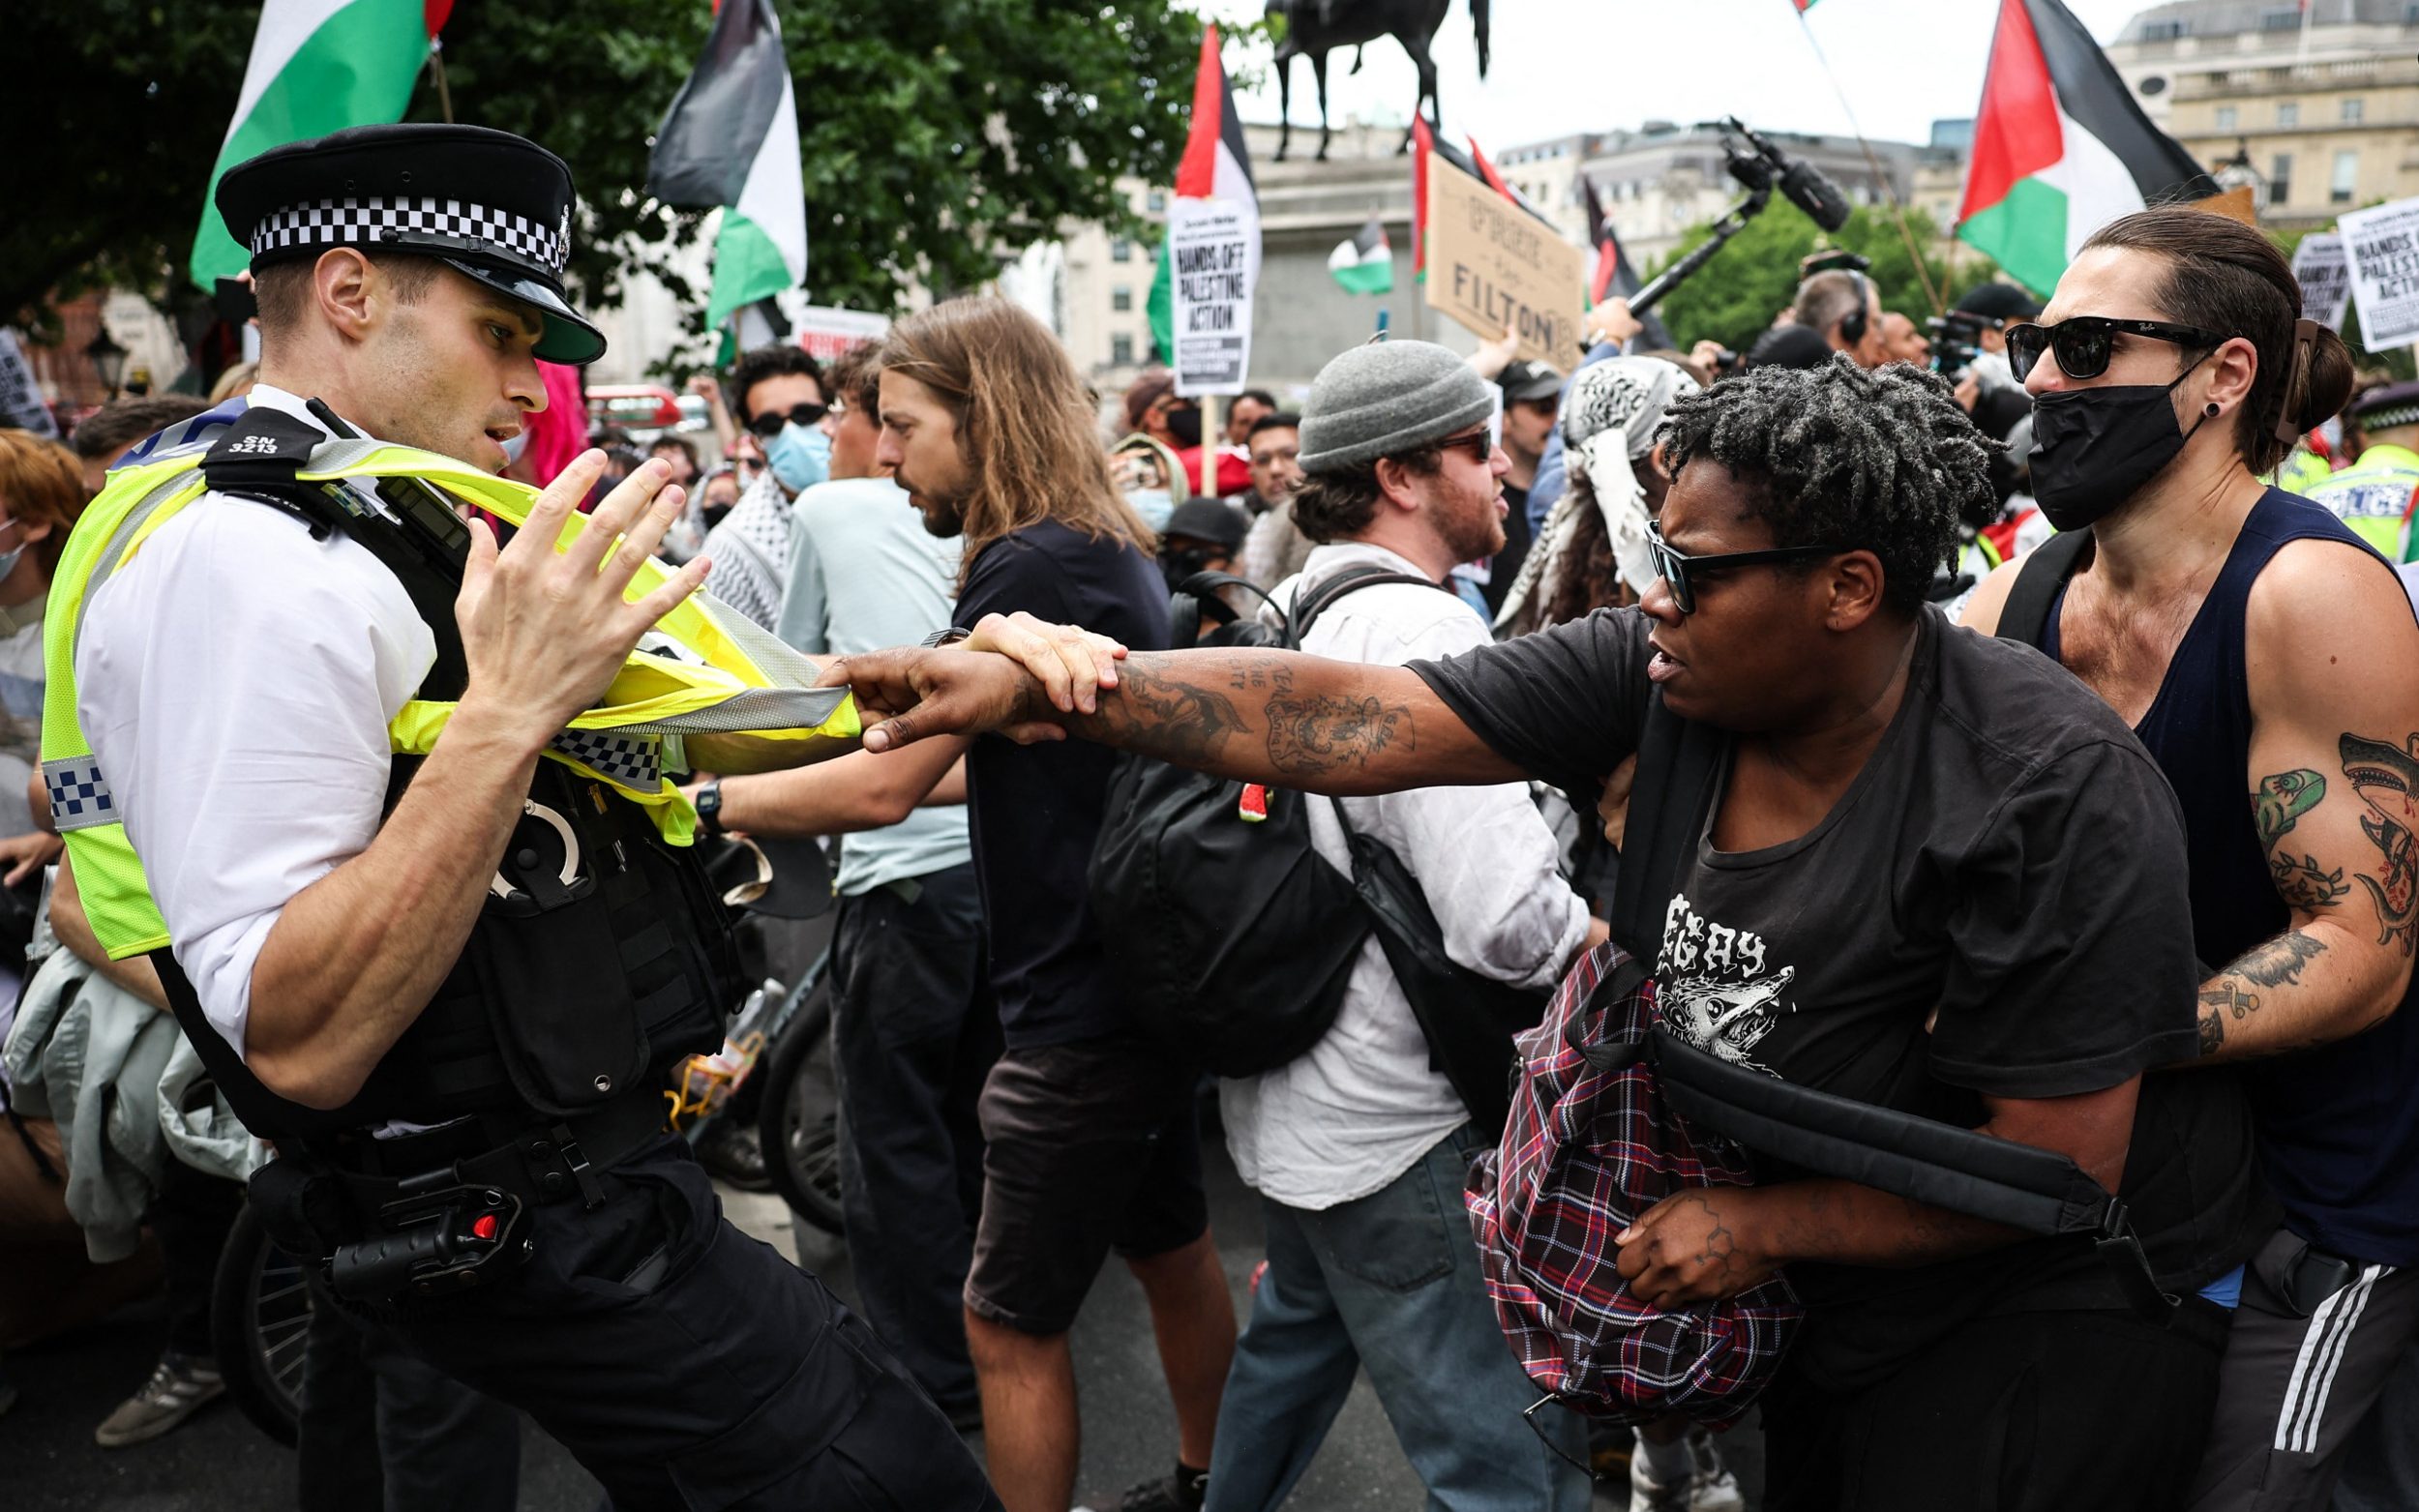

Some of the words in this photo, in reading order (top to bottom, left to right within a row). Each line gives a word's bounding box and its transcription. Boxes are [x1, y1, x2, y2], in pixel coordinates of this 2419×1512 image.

[1177, 245, 1217, 274] HANDS
[1222, 242, 1245, 271] OFF
[2355, 232, 2412, 261] HANDS
[1180, 273, 1245, 303] PALESTINE
[1188, 305, 1234, 332] ACTION
[1454, 262, 1554, 351] FILTON
[228, 443, 278, 454] 3213
[243, 435, 276, 445] SN
